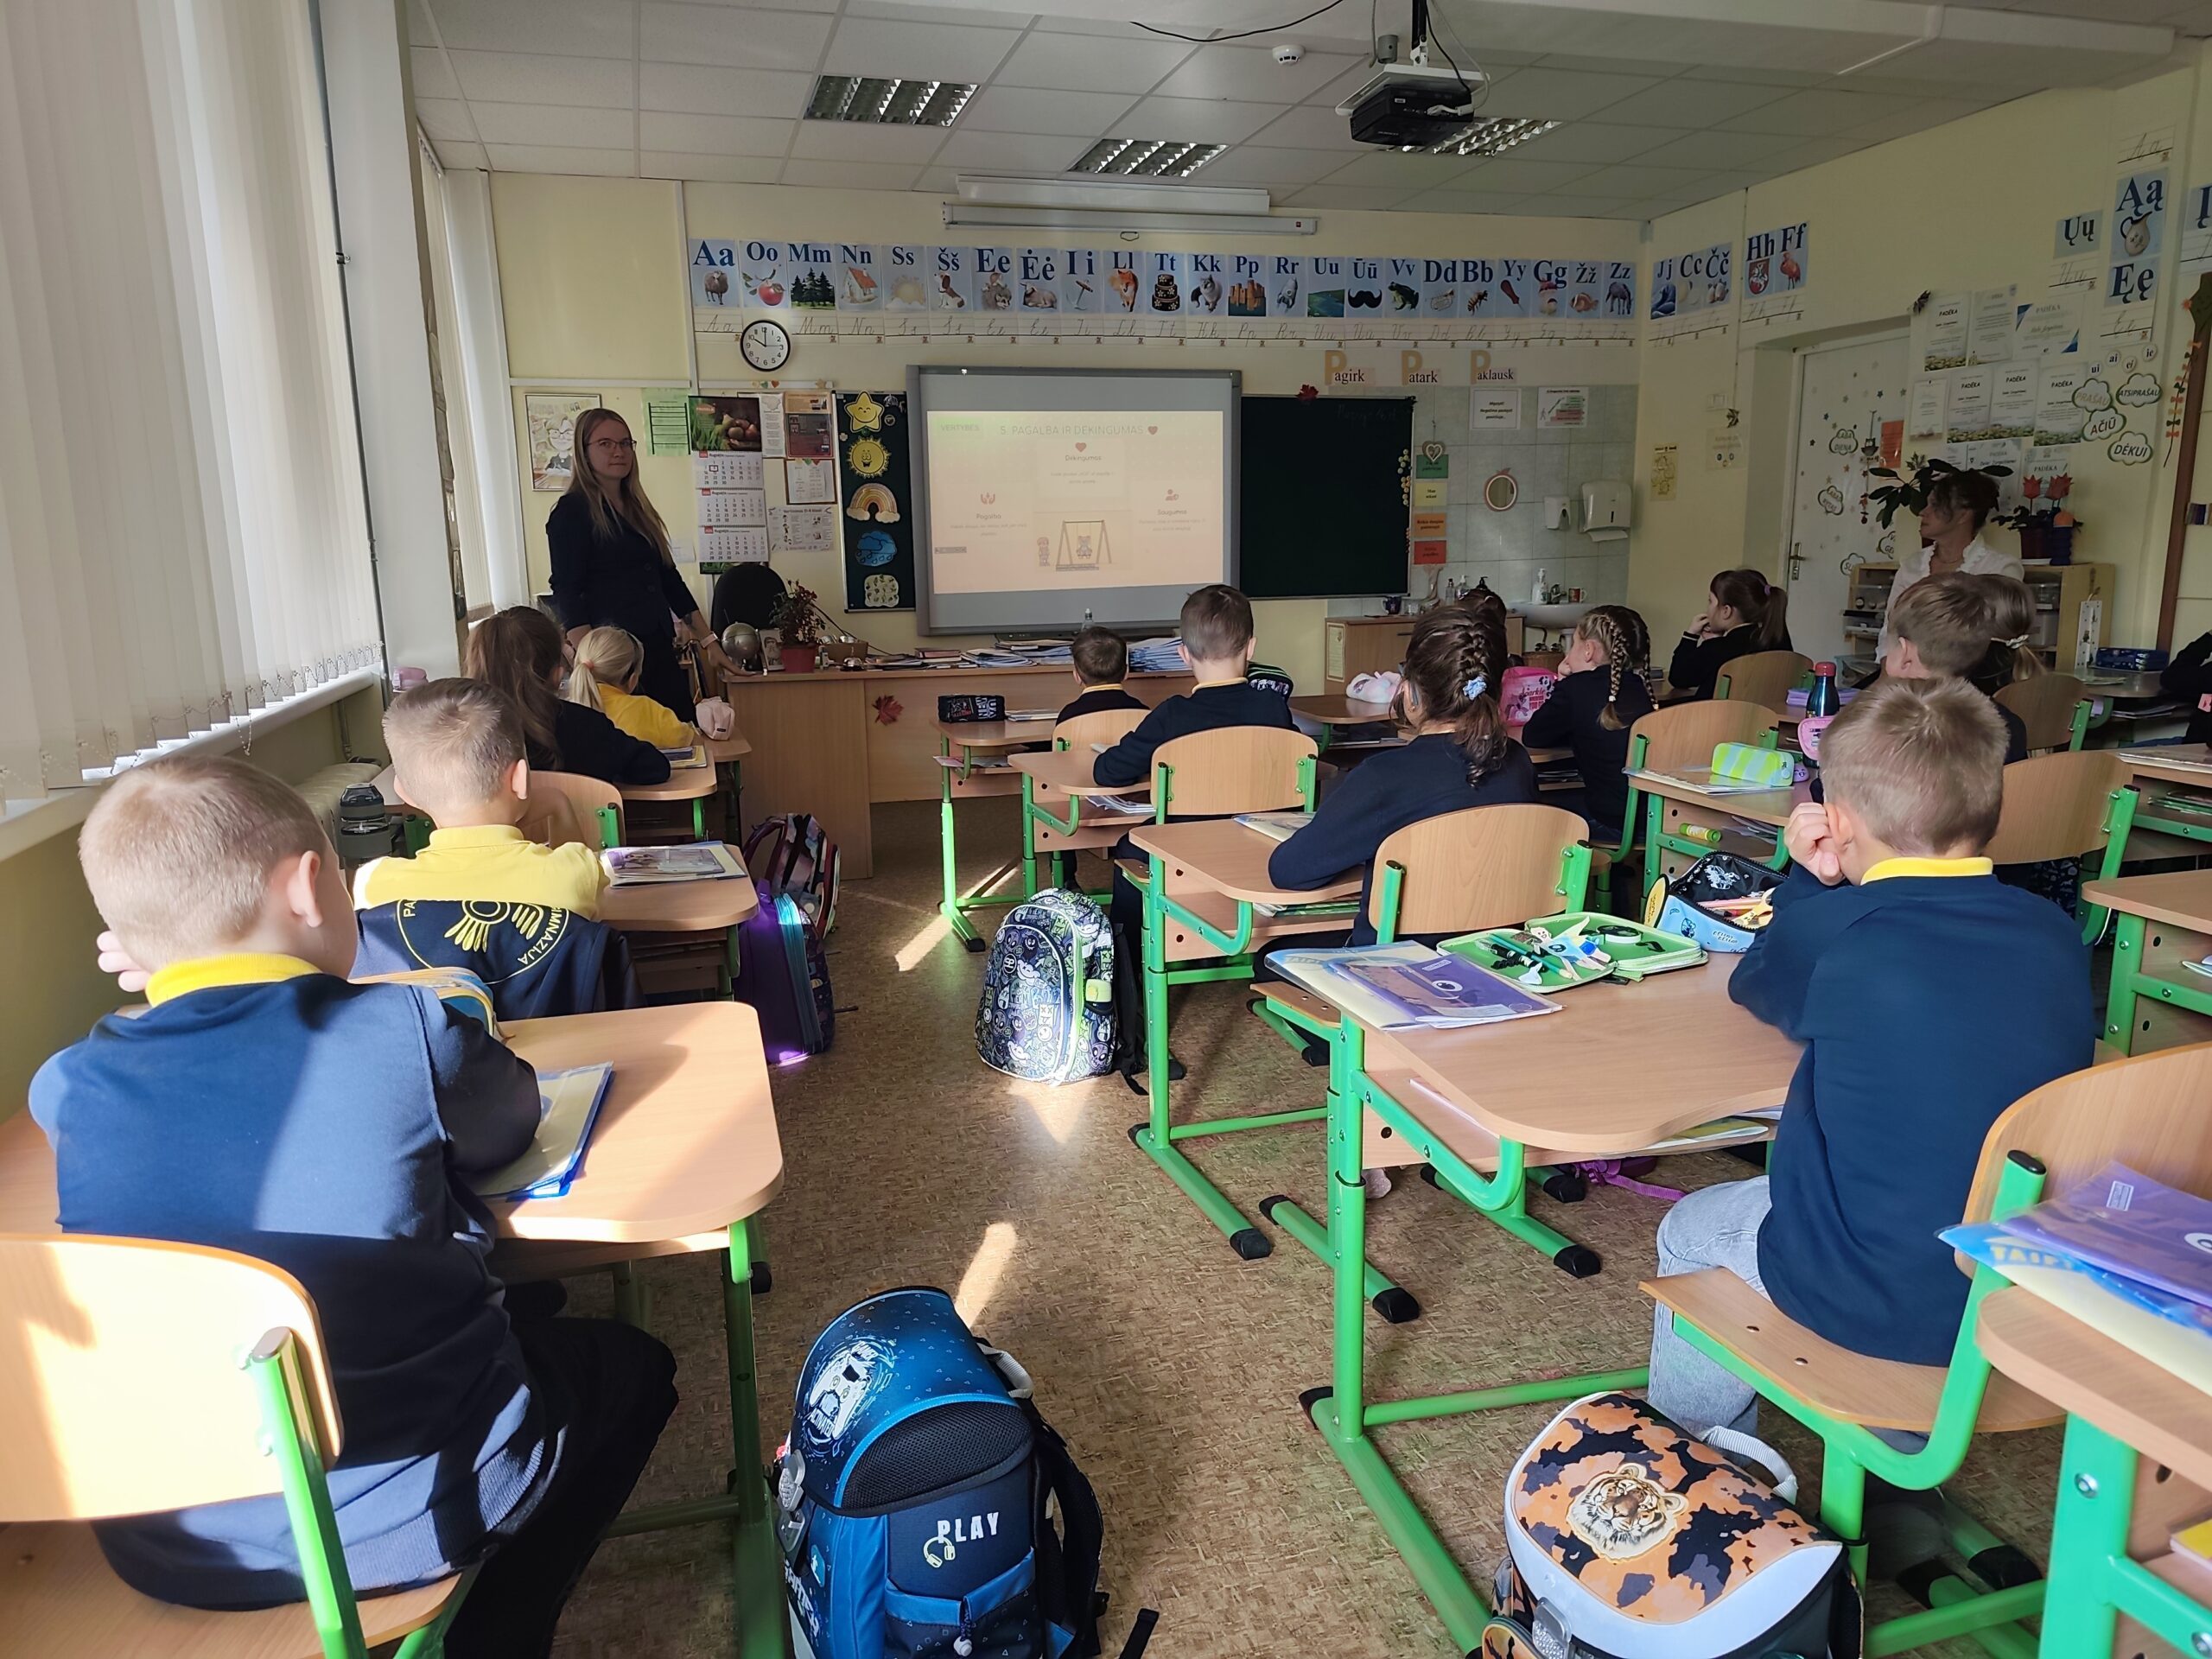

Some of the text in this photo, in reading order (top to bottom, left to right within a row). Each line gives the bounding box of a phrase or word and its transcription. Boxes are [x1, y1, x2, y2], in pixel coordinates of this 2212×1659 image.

[2115, 176, 2164, 216] Ąą
[1780, 223, 1808, 253] Ff
[2064, 216, 2095, 246] Ųų
[692, 240, 735, 267] Aa
[746, 241, 779, 262] Oo
[788, 243, 832, 264] Mm
[842, 245, 873, 264] Nn
[892, 246, 914, 266] Ss
[1745, 232, 1775, 262] Hh
[938, 247, 960, 271] Šš
[976, 248, 1011, 273] Ee
[1020, 249, 1055, 281] Ėė
[1112, 251, 1134, 270] Ll
[1154, 253, 1177, 271] Tt
[1193, 255, 1222, 273] Kk
[1236, 256, 1259, 278] Pp
[1275, 257, 1299, 275] Rr
[1314, 257, 1339, 275] Uu
[1352, 258, 1378, 279] Ūū
[1391, 259, 1415, 276] Vv
[1657, 258, 1672, 281] Jj
[1680, 254, 1702, 277] Cc
[1705, 247, 1730, 278] Čč
[1423, 260, 1458, 283] Dd
[1462, 260, 1494, 283] Bb
[1503, 260, 1527, 282] Yy
[1533, 260, 1567, 289] Gg
[1575, 264, 1597, 283] Žž
[1610, 263, 1631, 279] Zz
[2109, 263, 2154, 304] Ęę
[1012, 425, 1059, 435] PAGALBA
[1062, 425, 1071, 435] IR
[2090, 416, 2117, 435] AČIŪ
[2113, 442, 2148, 458] DĖKUI
[517, 906, 563, 965] IMNAZIJA
[937, 1512, 1000, 1543] PLAY
